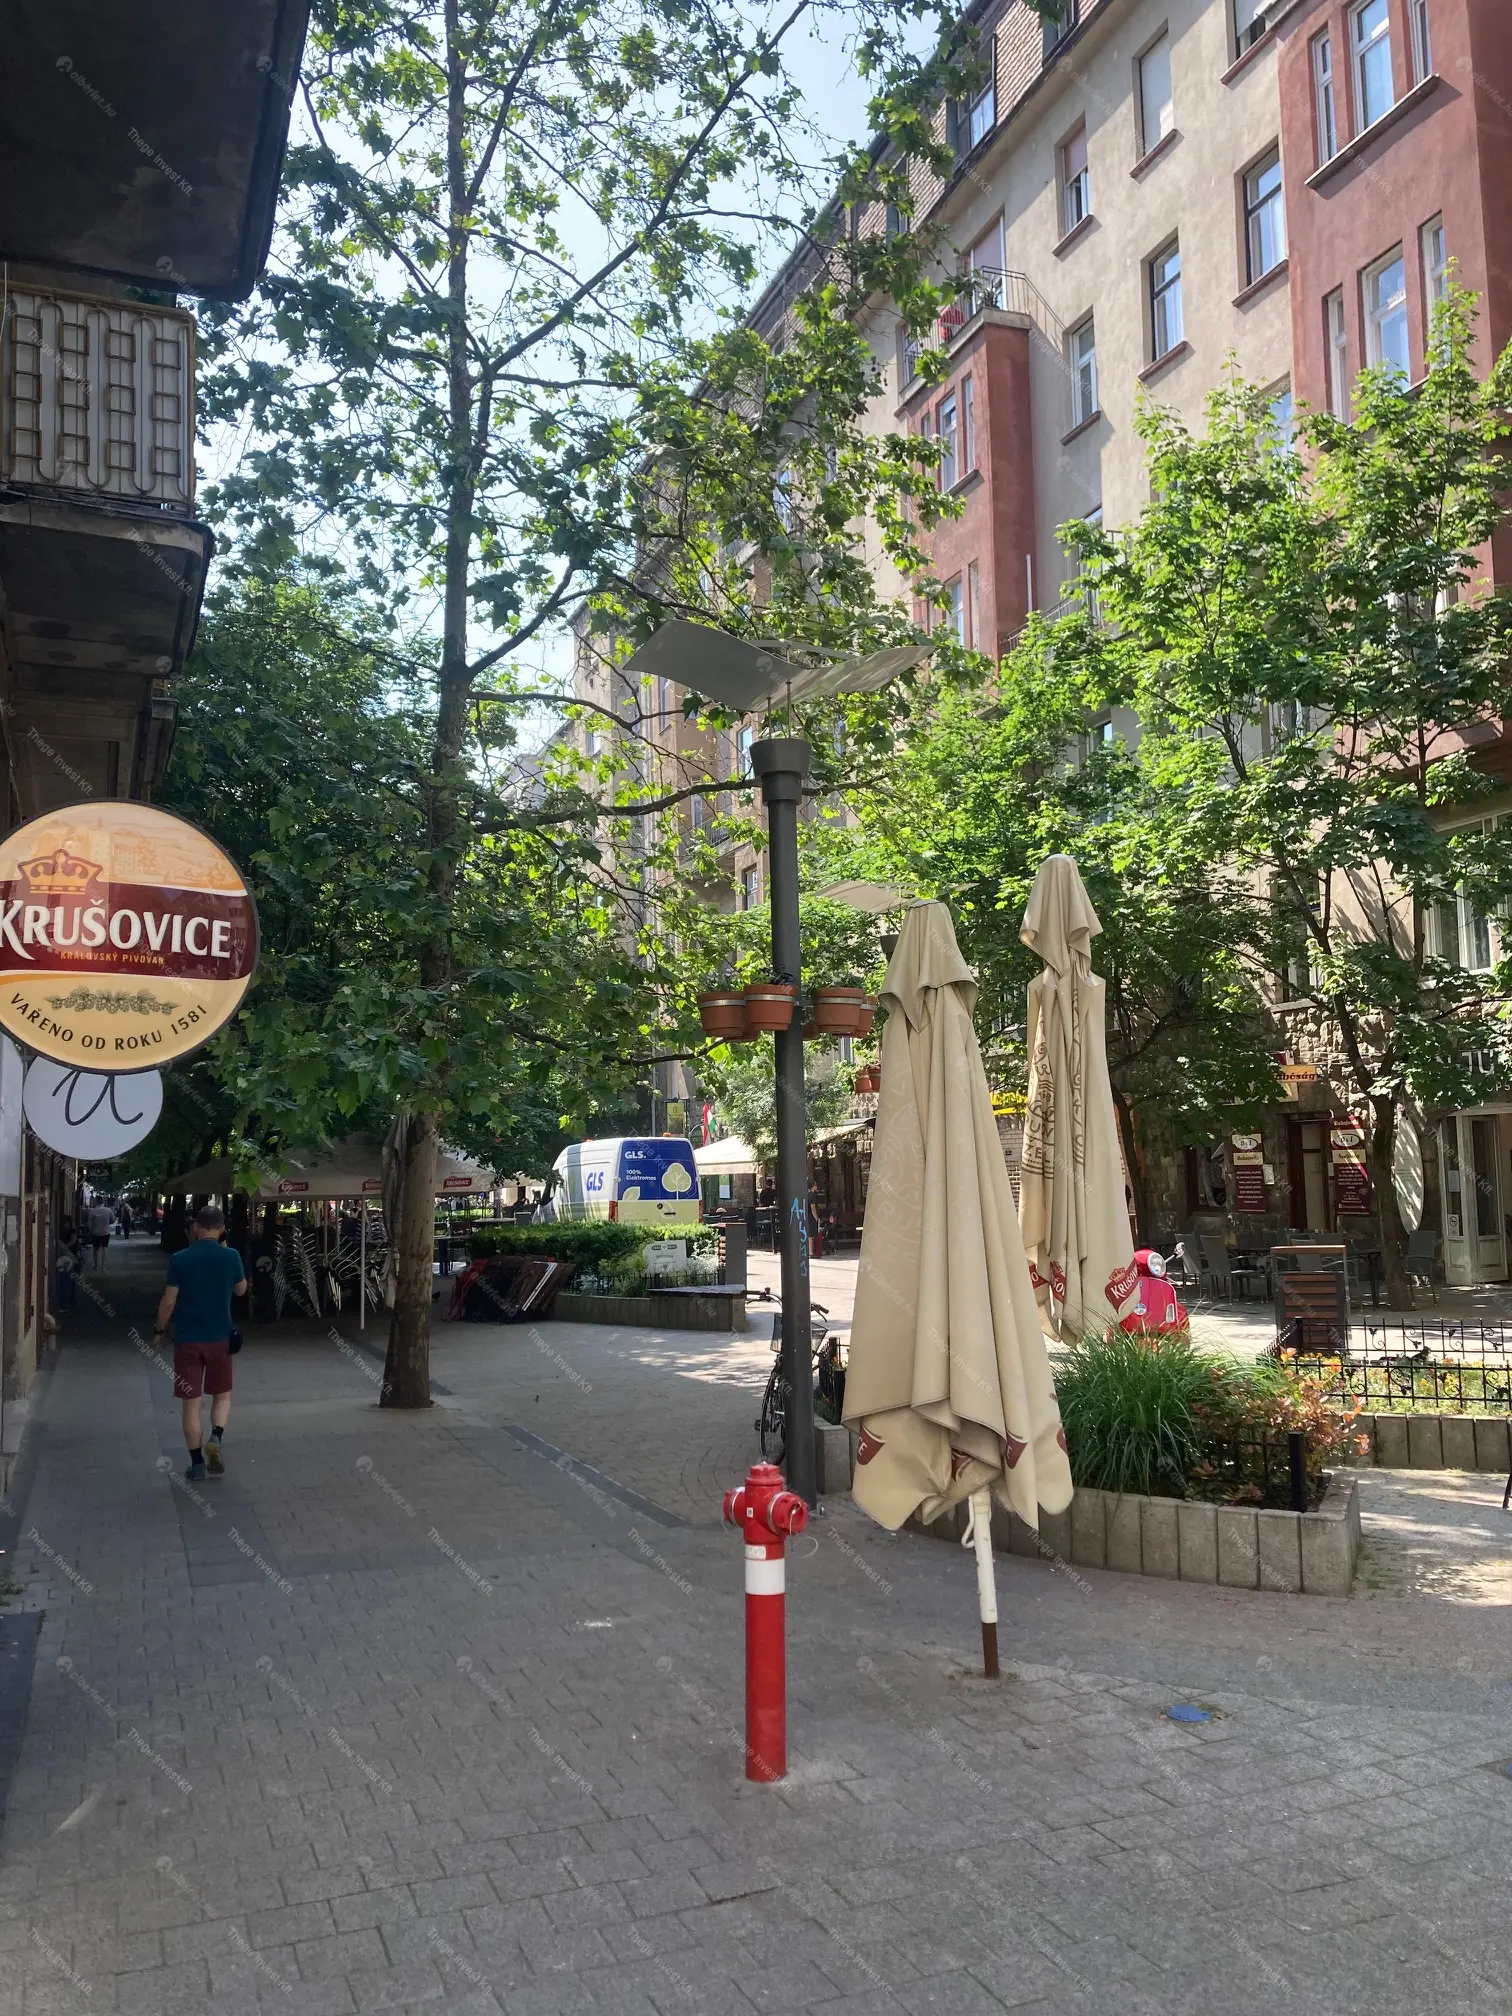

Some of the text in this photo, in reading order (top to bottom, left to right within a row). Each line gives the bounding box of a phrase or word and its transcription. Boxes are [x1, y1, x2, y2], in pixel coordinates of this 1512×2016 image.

[0, 899, 232, 961] KRUŠOVICE
[122, 954, 165, 966] PIVOVAR
[10, 992, 208, 1050] VAŘENO OD ROKU 1581
[586, 1171, 604, 1192] GLS
